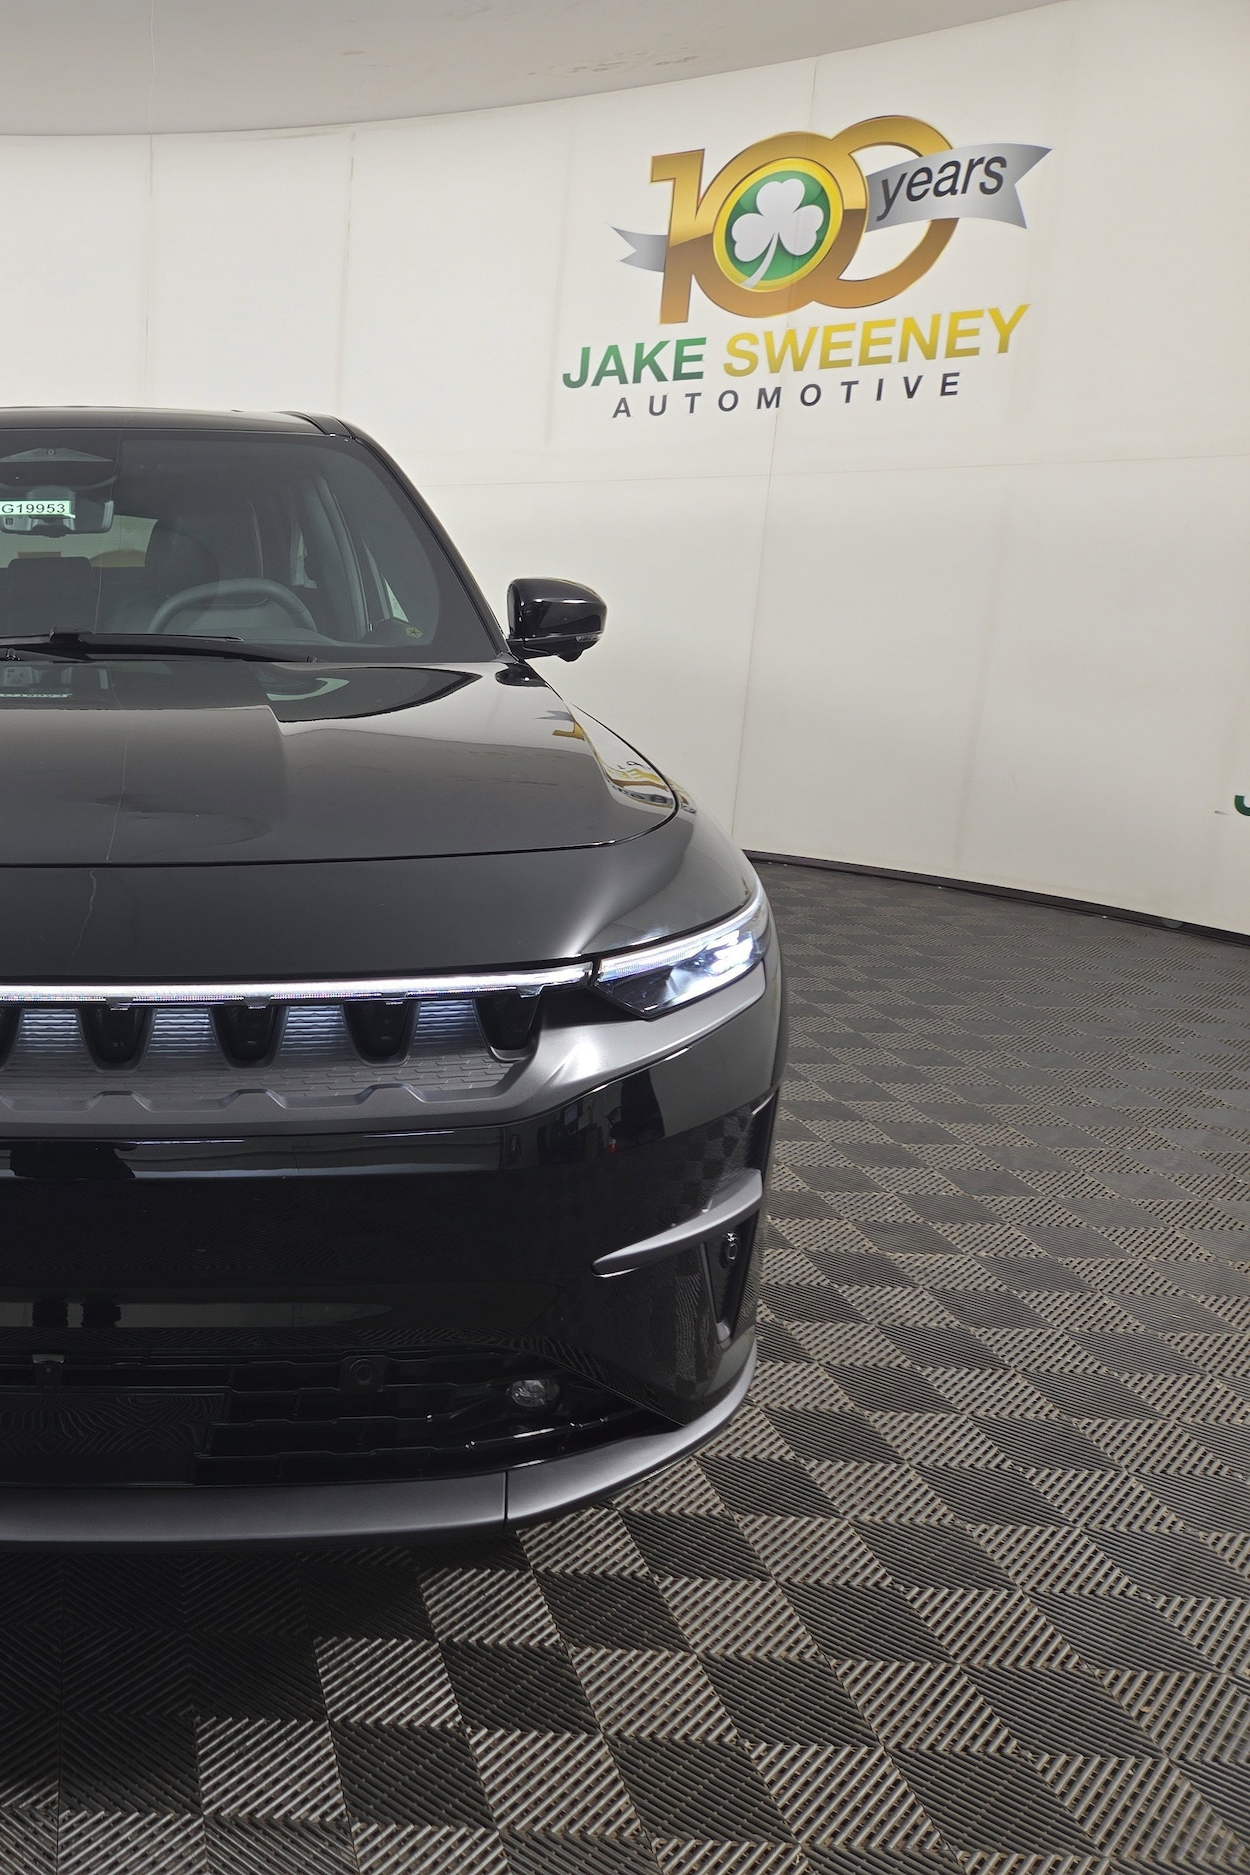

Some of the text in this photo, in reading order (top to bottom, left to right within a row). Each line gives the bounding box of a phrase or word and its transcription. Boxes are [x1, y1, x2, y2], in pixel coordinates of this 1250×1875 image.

[650, 115, 1007, 324] 100 years
[562, 304, 1030, 388] JAKE SWEENEY
[612, 372, 962, 418] AUTOMOTIVE
[1, 503, 66, 514] G19953
